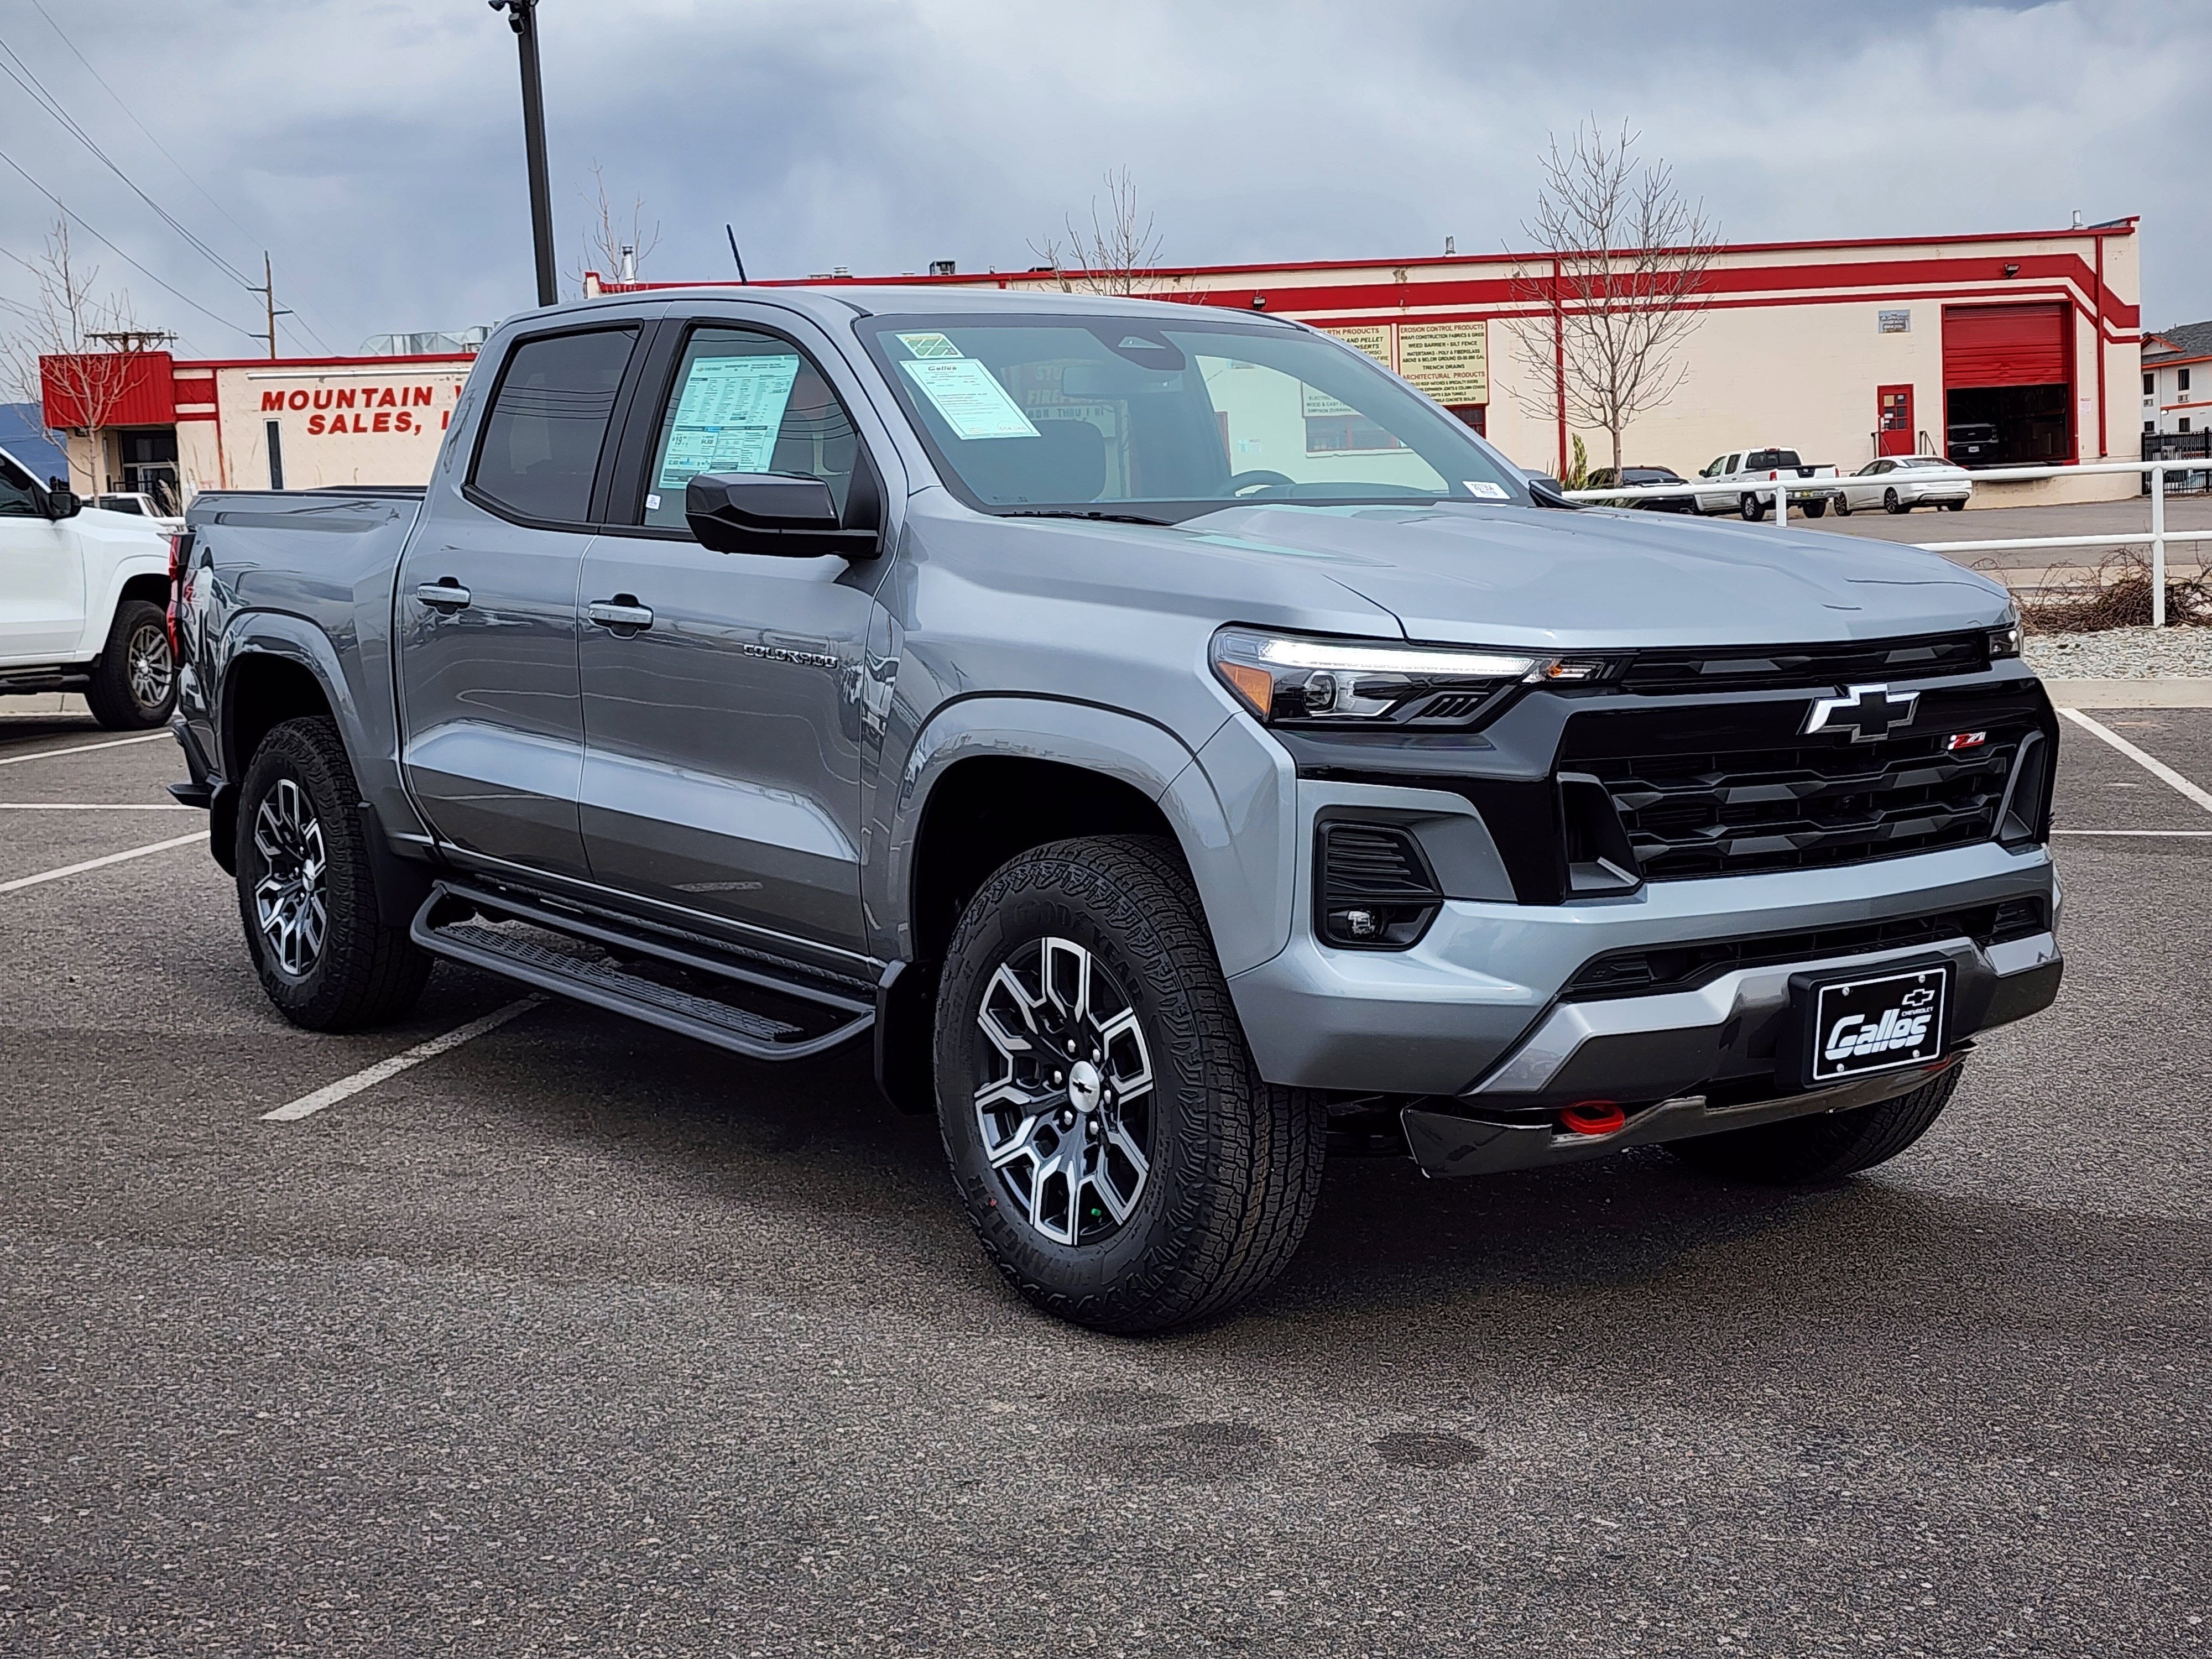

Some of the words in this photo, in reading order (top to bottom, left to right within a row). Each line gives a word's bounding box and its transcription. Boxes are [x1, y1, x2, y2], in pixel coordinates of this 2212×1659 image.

[261, 386, 433, 411] MOUNTAIN
[307, 411, 421, 436] SALES,
[1057, 408, 1081, 418] THRU
[744, 644, 839, 669] COLORADO
[1014, 899, 1144, 1005] GOODYEAR
[1901, 1006, 1934, 1016] CHEVROLET
[1825, 1008, 1932, 1060] Galles
